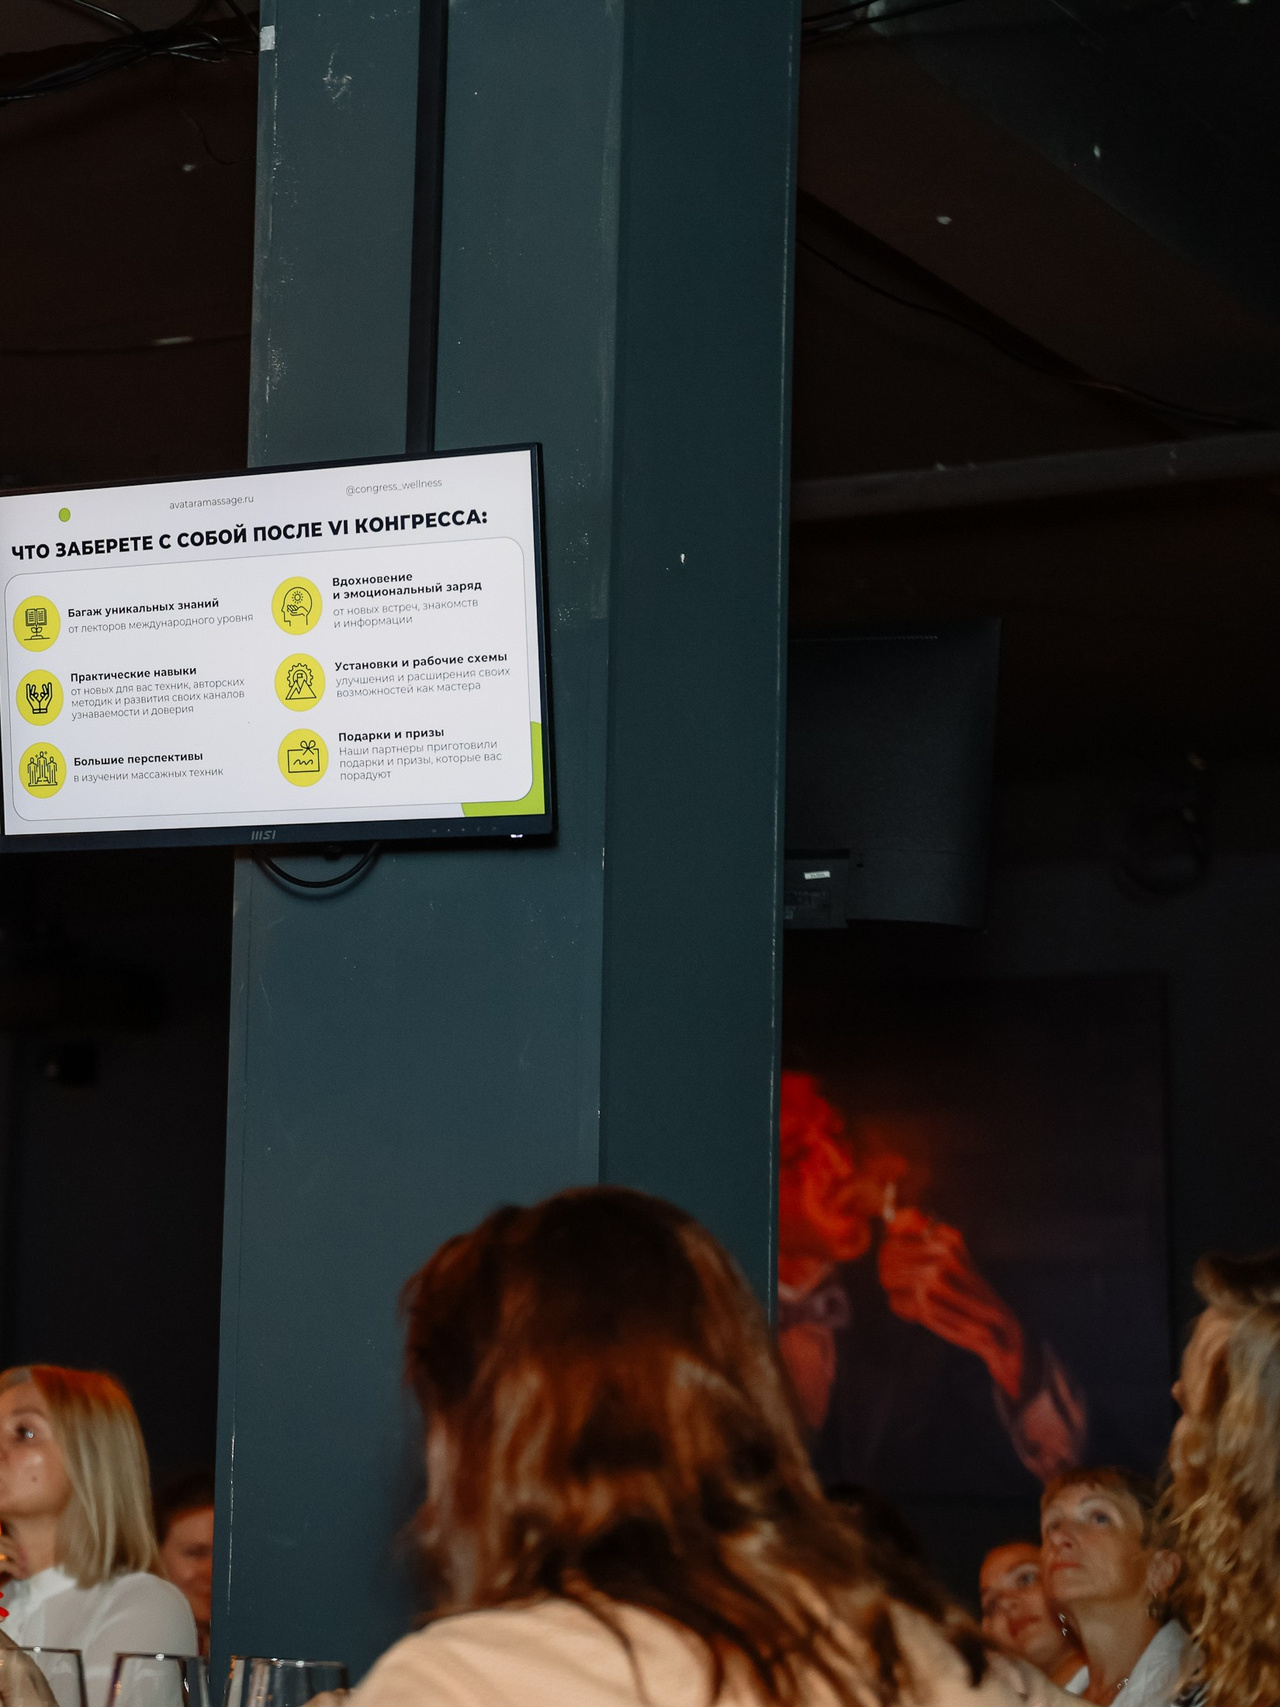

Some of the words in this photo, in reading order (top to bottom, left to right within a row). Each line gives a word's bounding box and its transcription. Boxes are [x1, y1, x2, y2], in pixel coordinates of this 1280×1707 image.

[346, 479, 443, 496] @congress_wellness
[170, 496, 254, 509] avataramassage.ru
[12, 544, 49, 560] ЧТО
[56, 535, 153, 557] ЗАБЕРЕТЕ
[159, 534, 171, 549] С
[177, 524, 246, 547] СОБОЙ
[254, 522, 322, 542] ПОСЛЕ
[328, 520, 348, 535] VI
[355, 509, 487, 533] КОНГРЕССА:
[333, 573, 413, 588] Вдохновение
[344, 582, 443, 599] эмоциональный
[447, 582, 483, 593] заряд
[68, 608, 103, 617] Багаж
[105, 603, 175, 617] уникальных
[178, 598, 219, 610] знаний
[333, 608, 345, 616] от
[347, 606, 380, 615] новых
[382, 603, 421, 613] встреч,
[423, 599, 479, 610] знакомств
[69, 625, 79, 633] от
[81, 622, 126, 633] лекторов
[129, 616, 216, 630] международного
[217, 613, 254, 626] уровня
[344, 616, 413, 628] информации
[335, 660, 398, 671] Установки
[402, 659, 410, 667] и
[413, 655, 464, 669] рабочие
[468, 653, 508, 663] схемы
[71, 670, 151, 684] Практические
[154, 667, 197, 677] навыки
[336, 674, 395, 688] улучшения
[408, 669, 475, 682] расширения
[479, 667, 511, 677] своих
[71, 688, 82, 696] от
[84, 686, 114, 694] новых
[116, 685, 134, 694] для
[136, 683, 153, 692] вас
[155, 682, 192, 690] техник,
[193, 678, 245, 689] авторских
[337, 684, 414, 697] возможностей
[437, 682, 481, 692] мастера
[72, 698, 113, 707] методик
[124, 694, 170, 706] развития
[172, 693, 201, 701] своих
[204, 690, 245, 699] каналов
[71, 708, 140, 721] узнаваемости
[151, 705, 194, 716] доверия
[339, 731, 391, 742] Подарки
[406, 729, 445, 740] призы
[339, 746, 370, 755] Наши
[372, 744, 424, 755] партнеры
[427, 741, 498, 753] приготовили
[74, 755, 124, 766] Большие
[128, 752, 203, 765] перспективы
[340, 758, 385, 768] подарки
[397, 756, 434, 767] призы,
[436, 753, 482, 764] которые
[484, 752, 502, 761] вас
[74, 774, 80, 782] в
[82, 773, 129, 783] изучении
[131, 770, 187, 779] массажных
[189, 768, 224, 776] техник
[340, 770, 392, 781] порадуют
